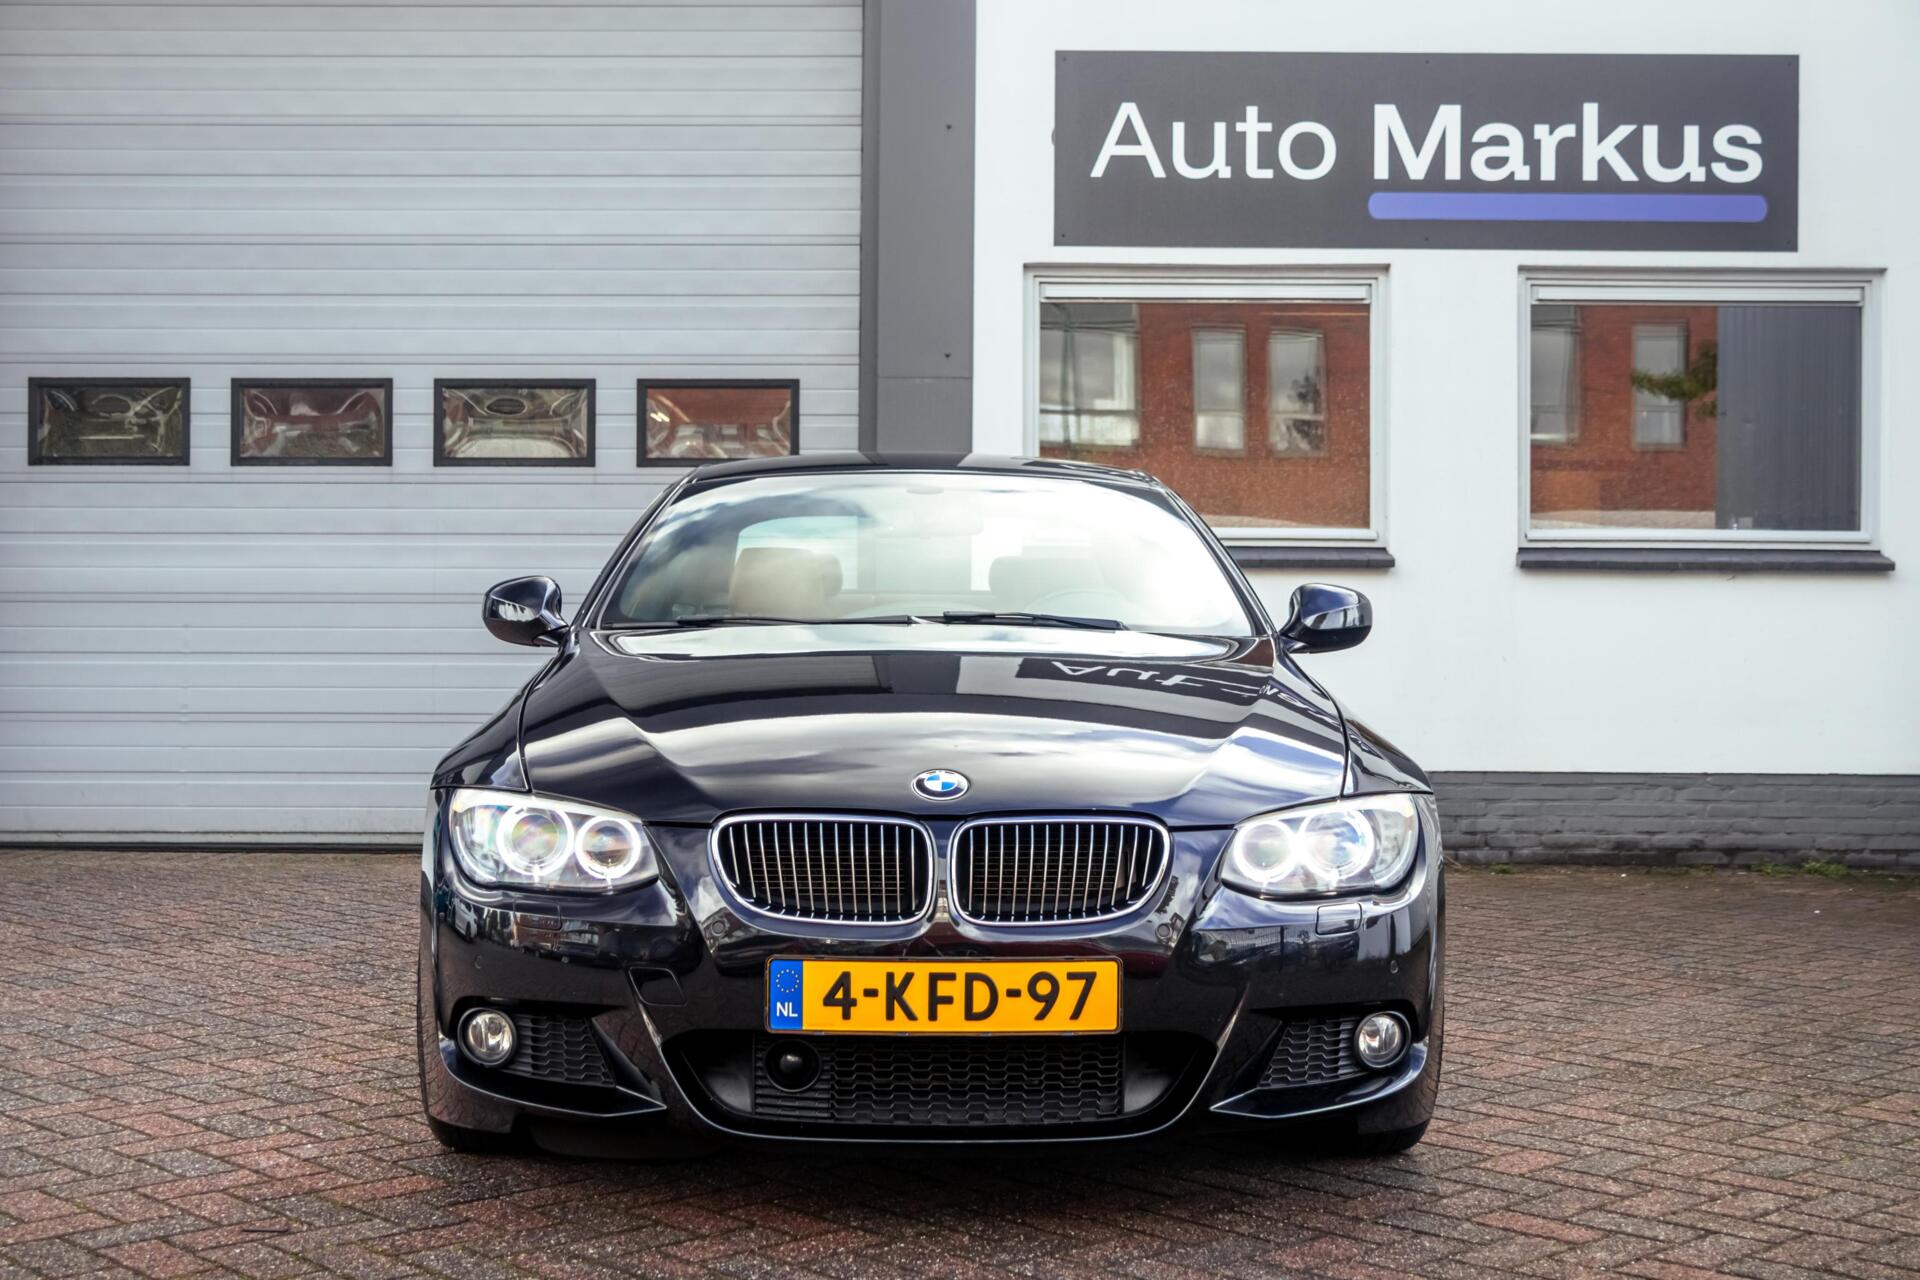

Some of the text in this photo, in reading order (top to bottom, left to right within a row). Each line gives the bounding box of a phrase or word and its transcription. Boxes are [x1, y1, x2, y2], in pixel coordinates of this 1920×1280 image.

[1090, 101, 1764, 183] Auto Markus
[776, 1001, 799, 1018] NL
[822, 971, 1097, 1022] 4-KFD-97
